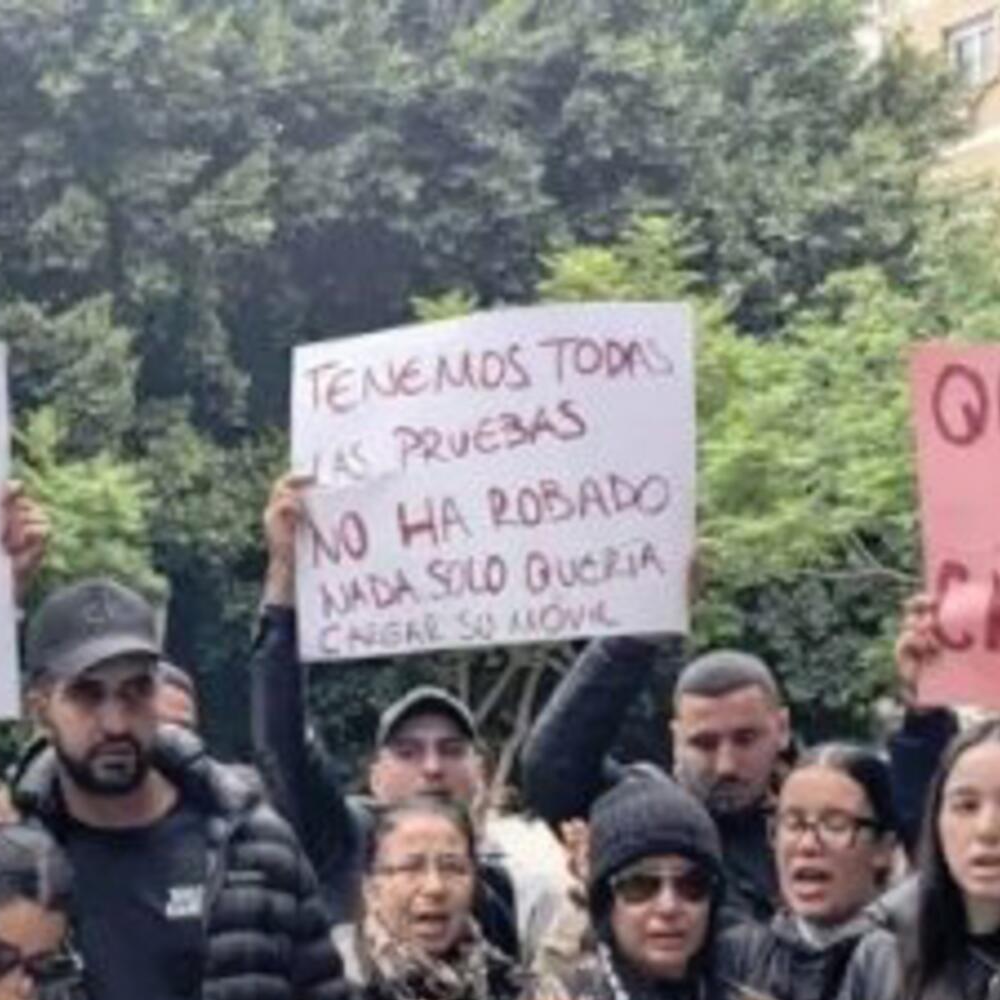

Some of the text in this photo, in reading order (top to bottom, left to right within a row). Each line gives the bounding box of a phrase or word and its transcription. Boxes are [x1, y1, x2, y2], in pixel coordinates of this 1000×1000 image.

[304, 336, 674, 414] TENEMOS TODAS
[931, 364, 1000, 446] Q
[392, 399, 587, 472] PRUEBAS
[302, 473, 671, 569] NO HA ROBADO
[319, 568, 420, 619] NADA
[427, 554, 507, 602] SOLO
